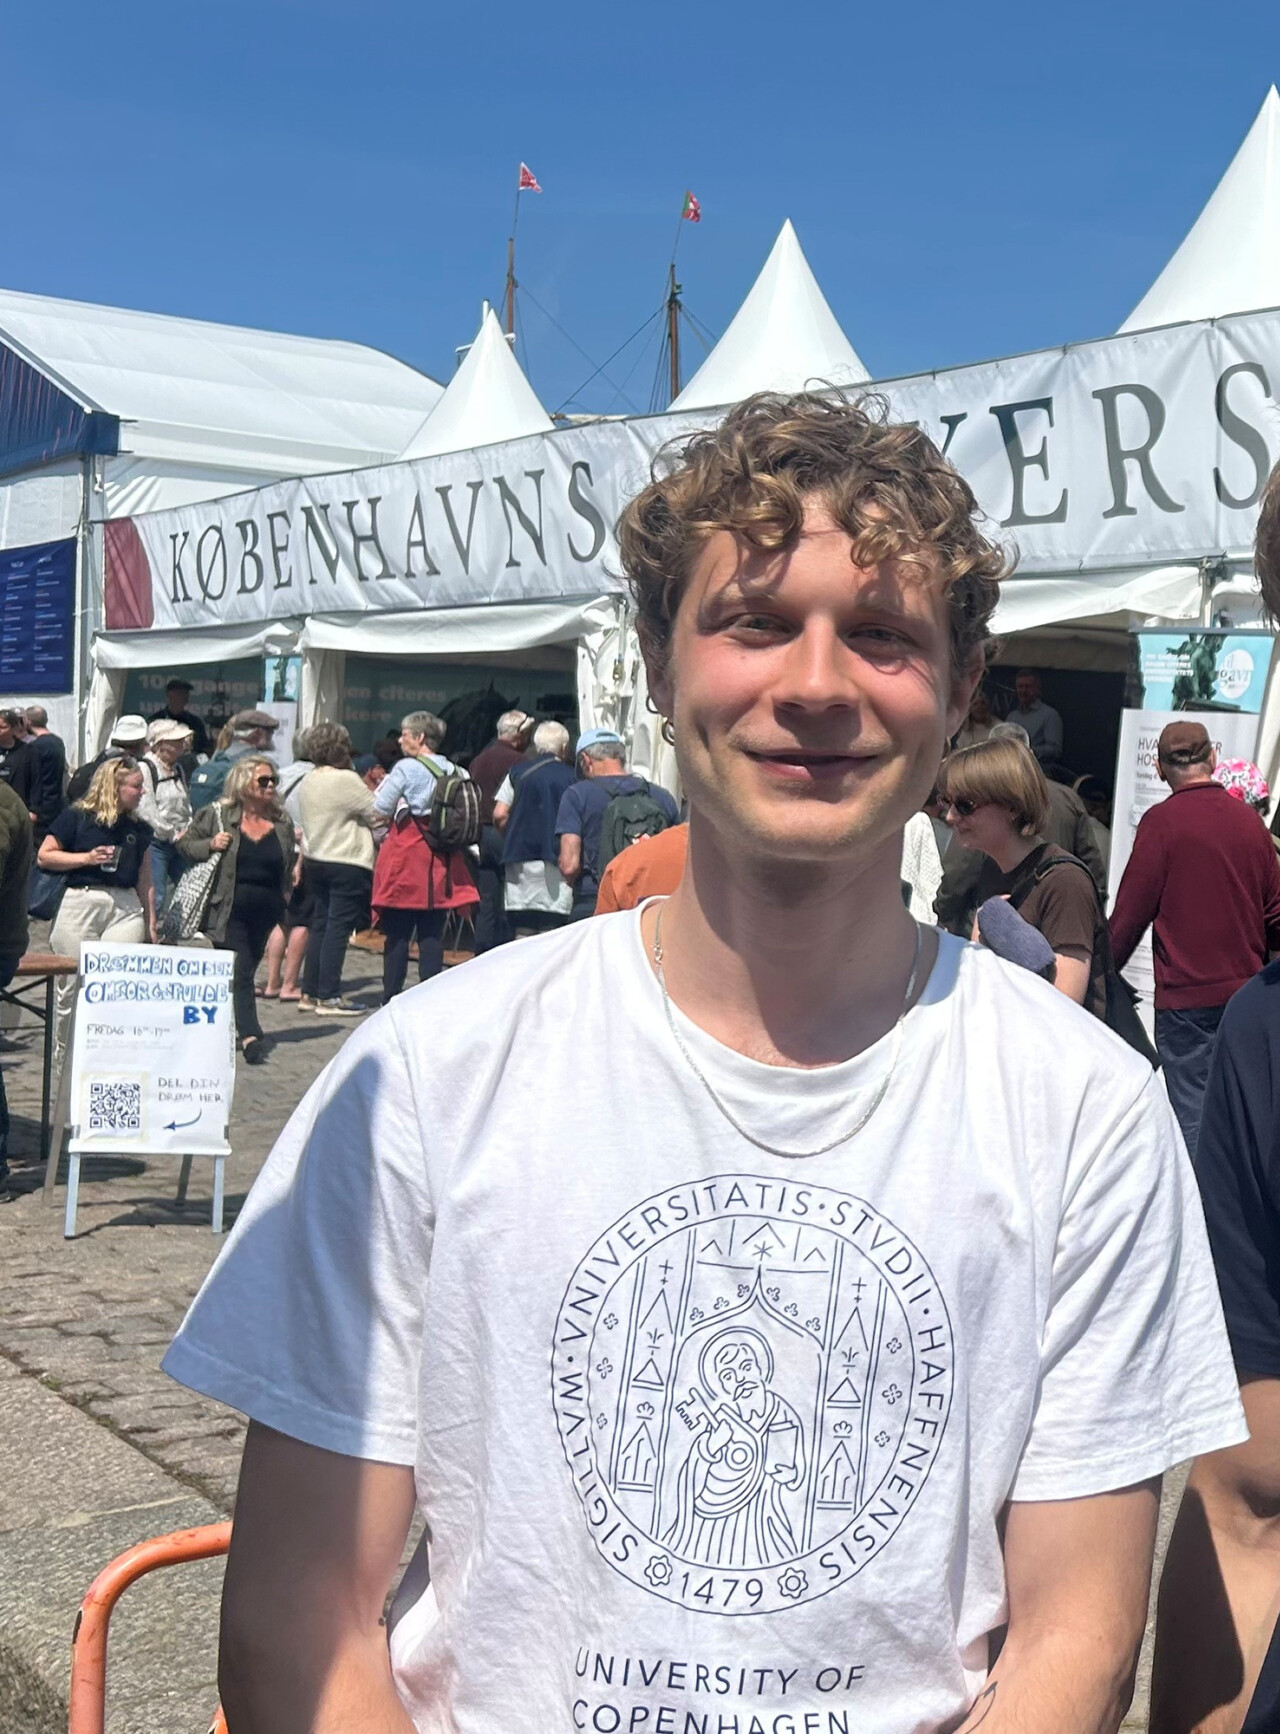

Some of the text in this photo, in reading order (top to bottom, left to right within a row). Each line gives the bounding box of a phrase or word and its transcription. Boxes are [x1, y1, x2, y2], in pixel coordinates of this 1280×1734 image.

[169, 461, 605, 605] KØBENHAVNS
[177, 959, 200, 976] OM
[183, 1005, 218, 1025] BY
[158, 1077, 220, 1089] DEL DIN
[559, 1181, 946, 1580] SIGILLVM VNIVERSITATIS STVDII HAFFNENSIS
[682, 1571, 764, 1607] 1479
[575, 1646, 866, 1696] UNIVERSITY OF
[572, 1699, 850, 1734] COPENHAGEN
